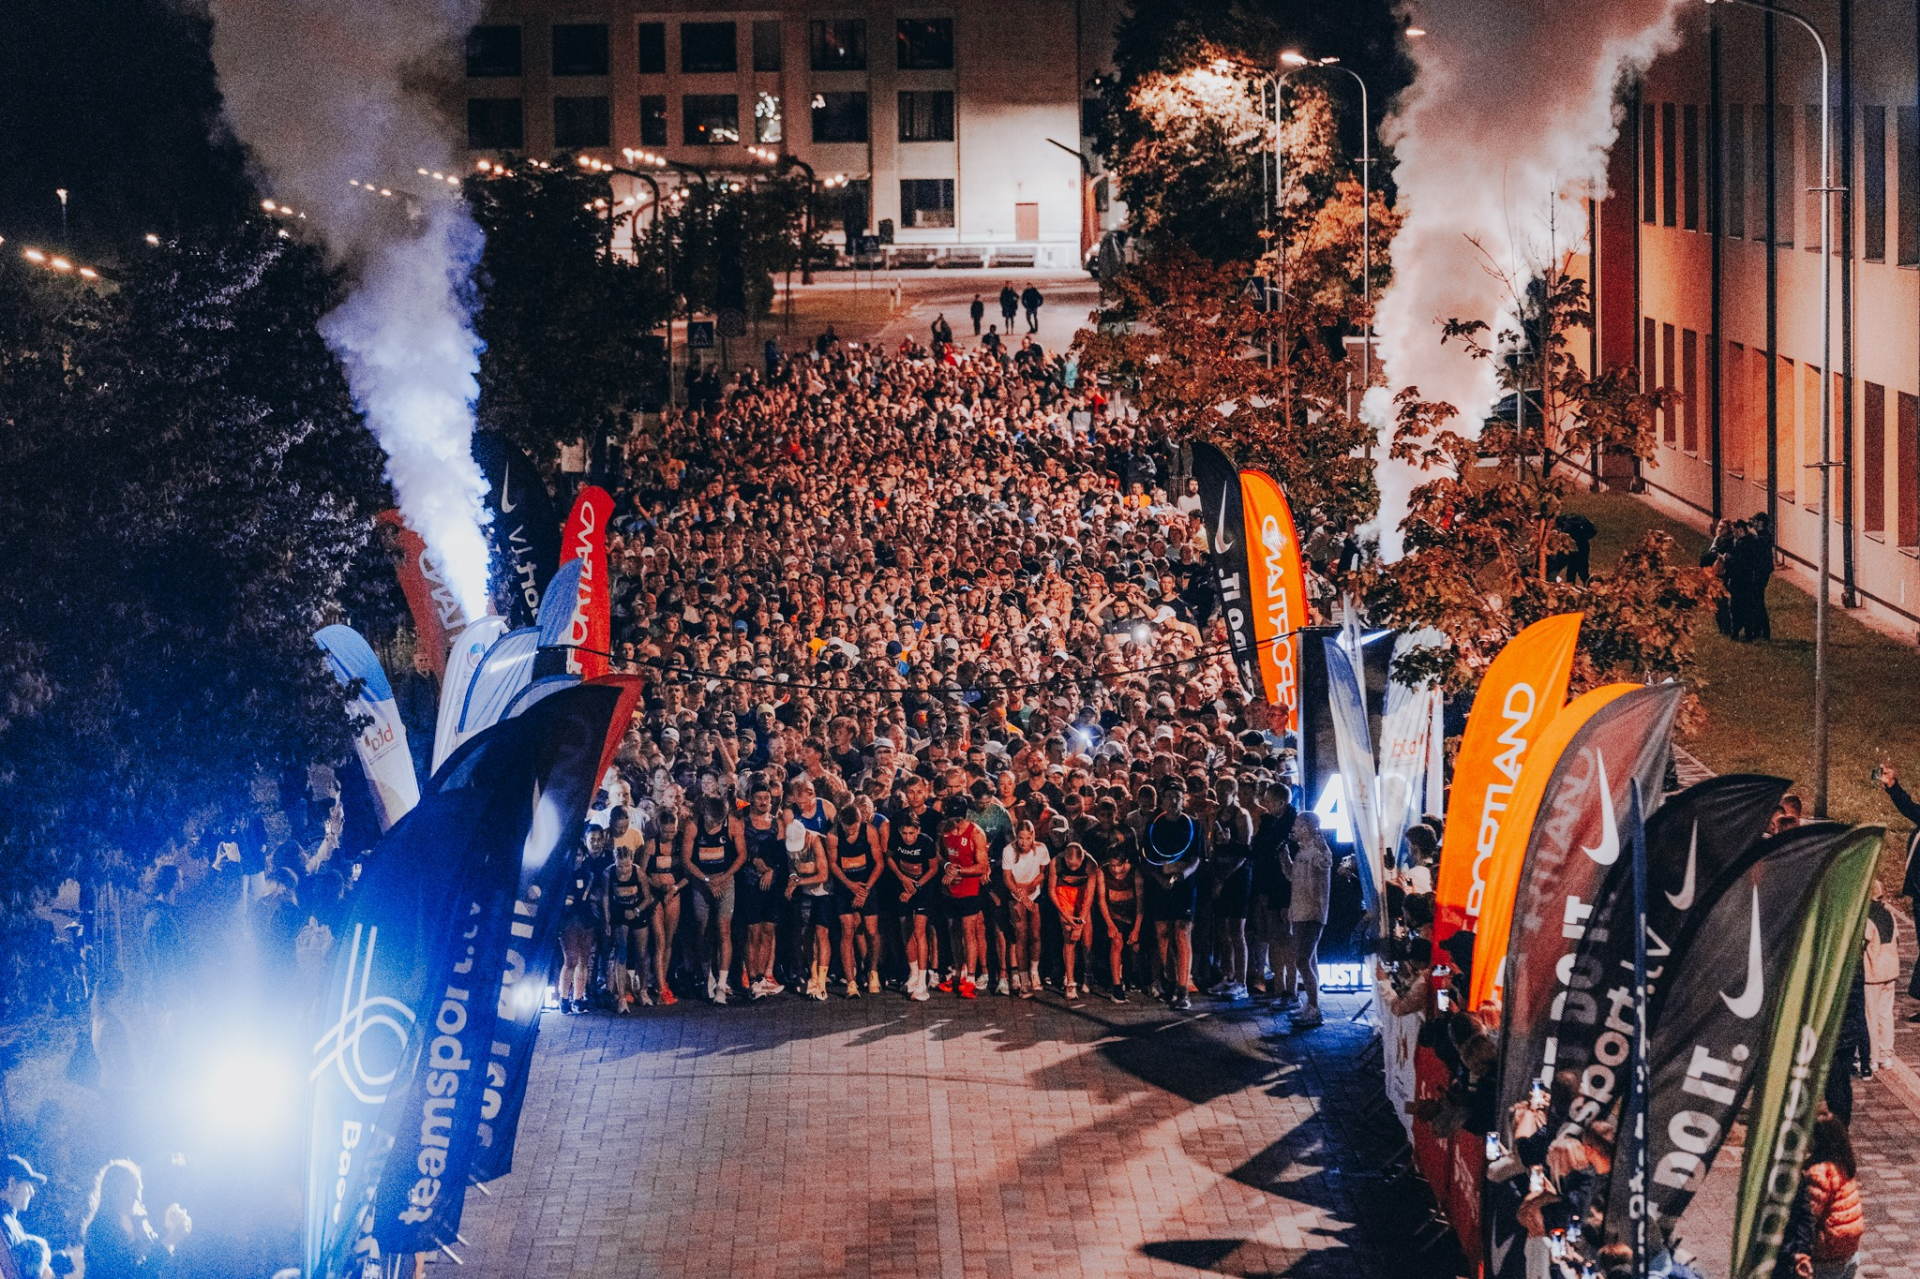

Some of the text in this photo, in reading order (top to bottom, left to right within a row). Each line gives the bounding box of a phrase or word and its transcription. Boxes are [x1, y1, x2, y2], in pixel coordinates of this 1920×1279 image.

[897, 846, 922, 856] NIKE
[1462, 682, 1536, 926] PORTLAND
[1653, 1044, 1750, 1193] DO IT.
